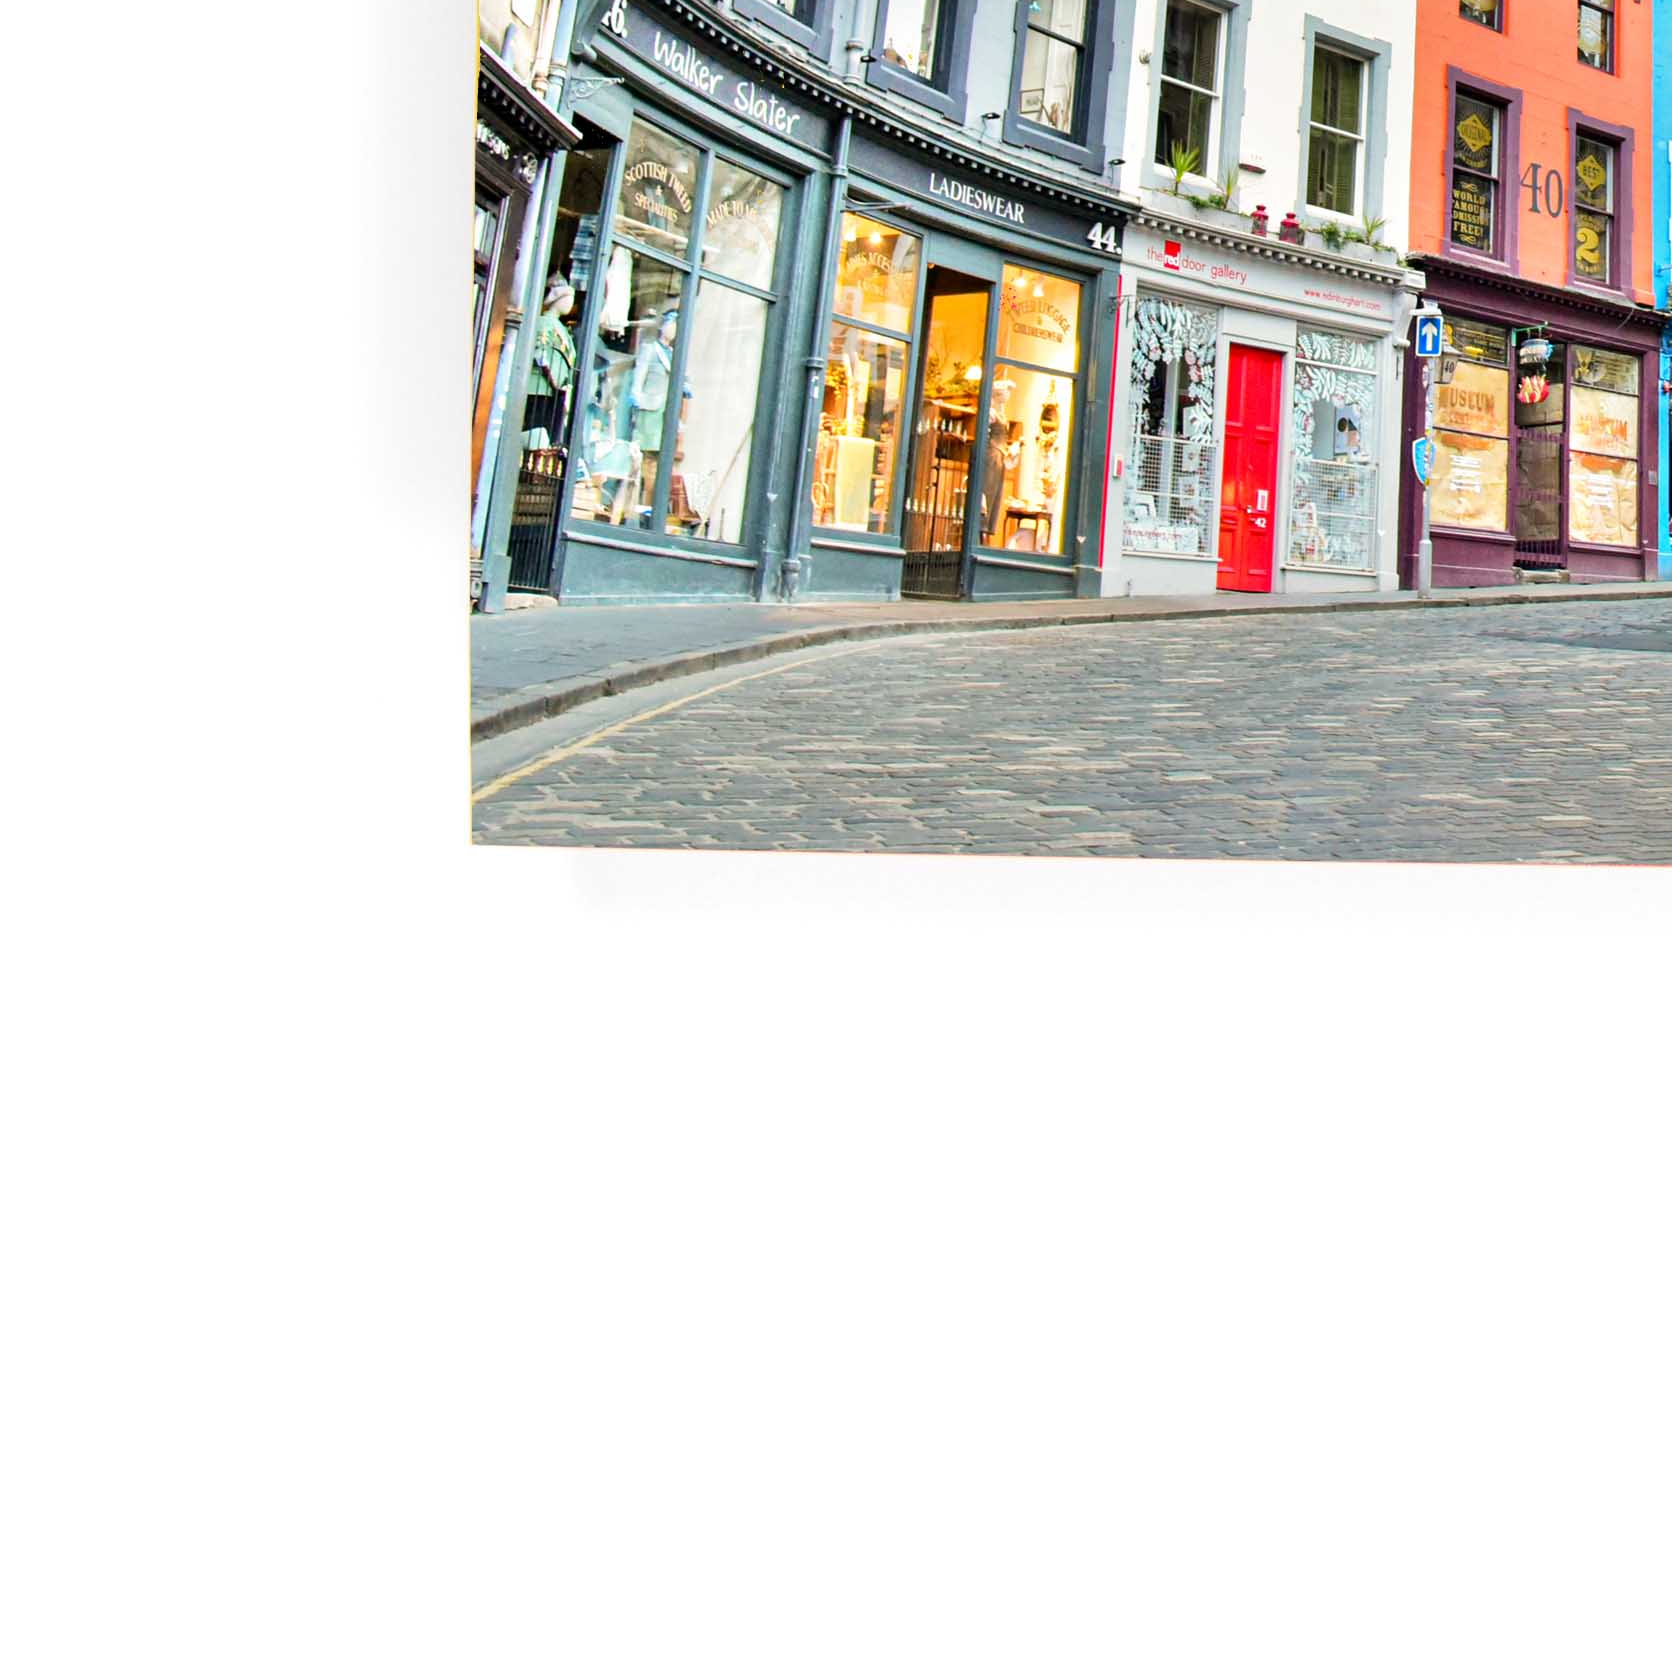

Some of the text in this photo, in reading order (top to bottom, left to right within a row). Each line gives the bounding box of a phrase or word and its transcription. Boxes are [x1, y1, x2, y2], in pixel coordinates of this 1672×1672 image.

[653, 31, 800, 135] Walker Slater
[624, 161, 668, 186] SCOTTISH
[1582, 164, 1601, 179] BEST
[656, 185, 663, 196] &
[929, 173, 1025, 224] LADIESWEAR
[1453, 189, 1486, 205] WORLD
[1520, 162, 1563, 218] 40
[1453, 200, 1488, 215] AMOU
[1087, 222, 1122, 254] 44.
[1576, 228, 1601, 264] 2
[1147, 245, 1247, 285] the red door gallery
[1255, 517, 1266, 528] 42
